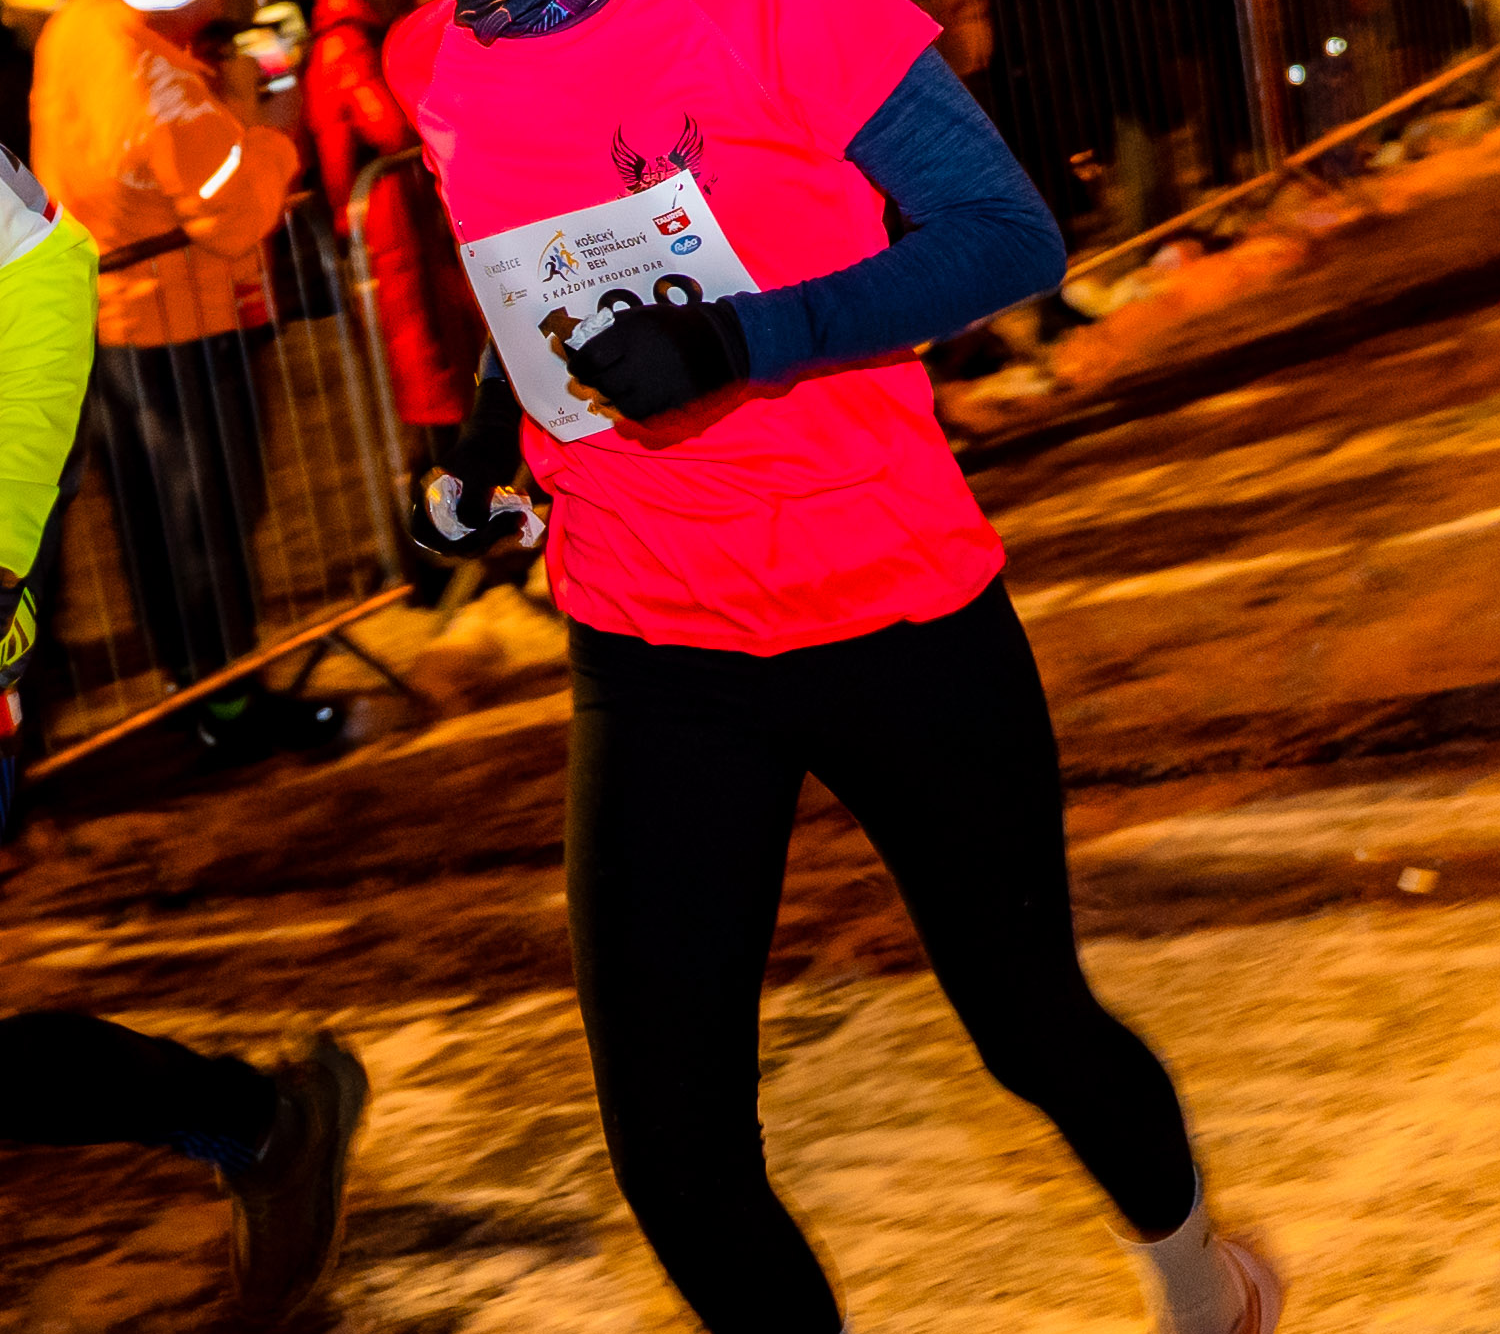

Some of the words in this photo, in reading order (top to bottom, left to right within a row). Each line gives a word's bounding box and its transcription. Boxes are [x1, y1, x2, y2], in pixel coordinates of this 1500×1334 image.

[574, 228, 616, 249] KOŠICKÝ
[580, 232, 648, 260] TROJKRÁĽOVÝ
[587, 258, 608, 271] BEH
[542, 293, 549, 303] S
[553, 279, 596, 300] KAŽDÝM
[599, 269, 641, 285] KROKOM
[643, 260, 664, 273] DAR
